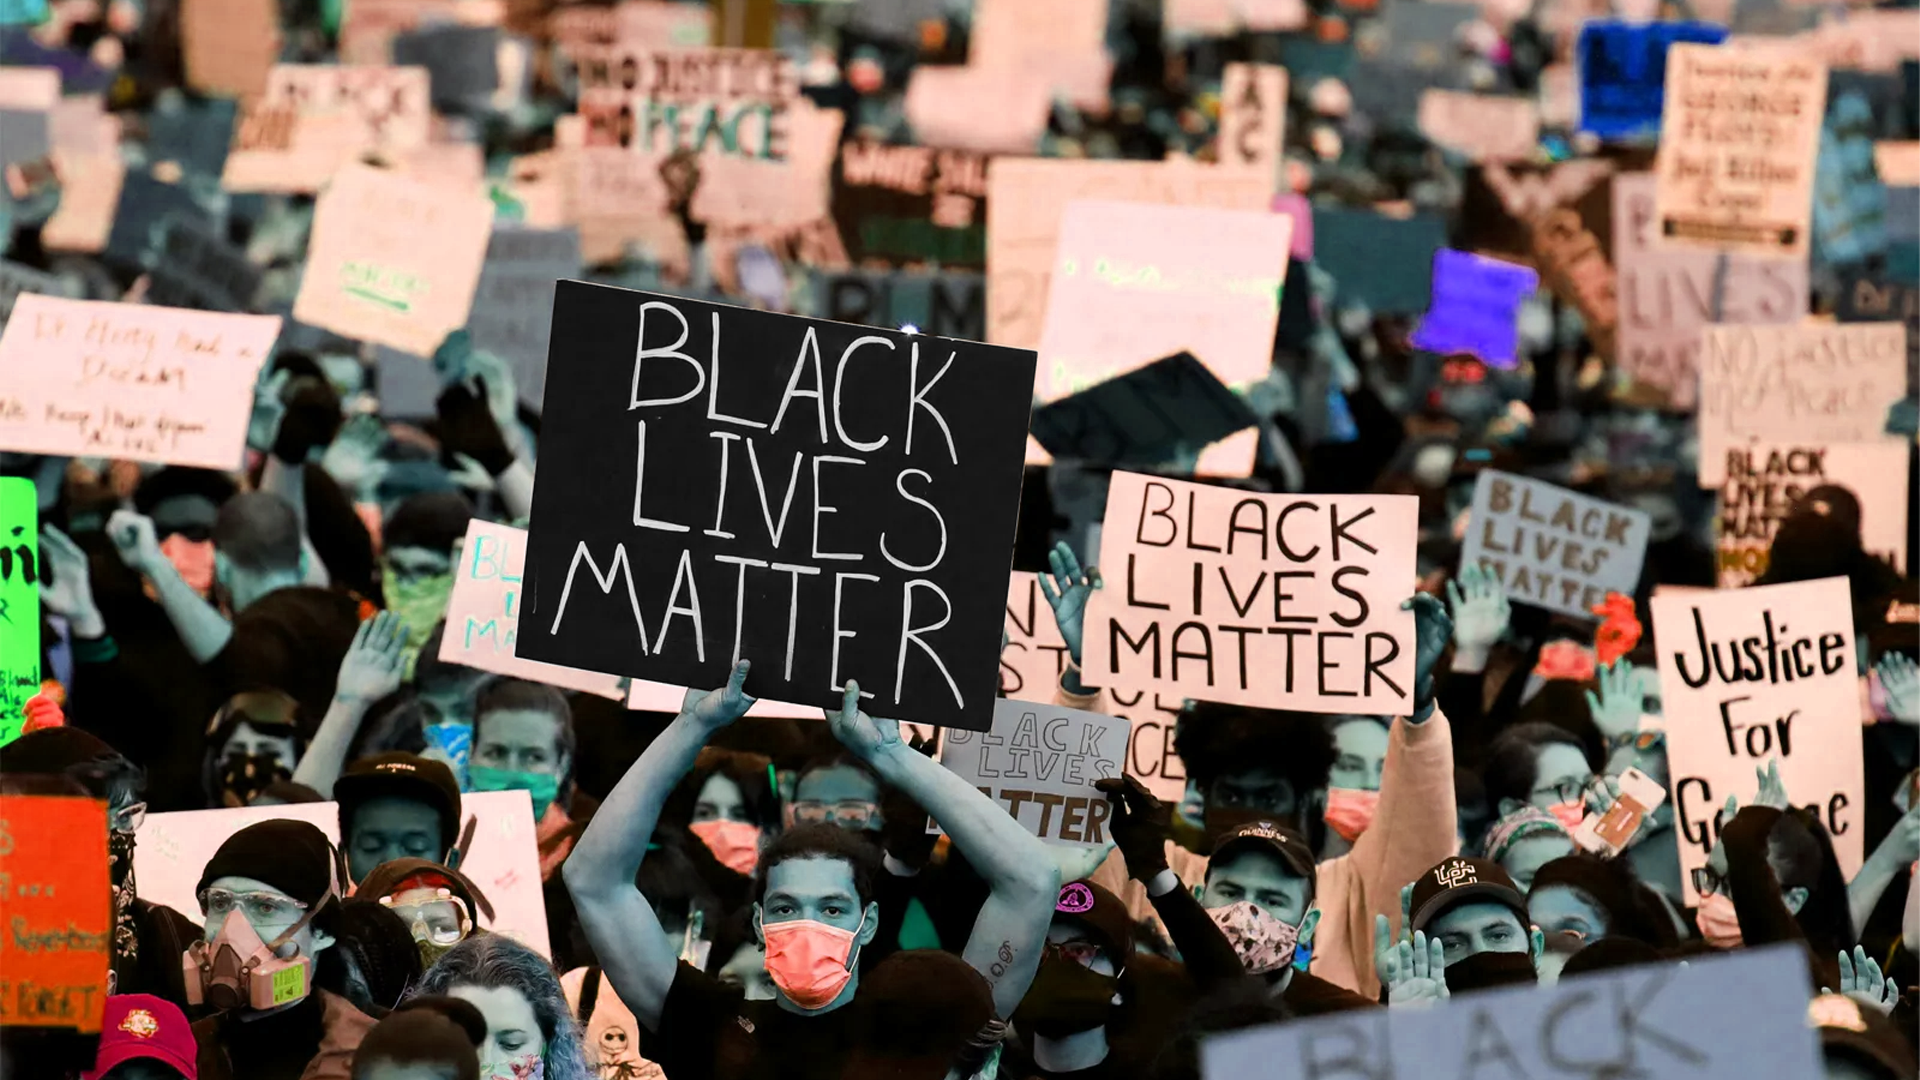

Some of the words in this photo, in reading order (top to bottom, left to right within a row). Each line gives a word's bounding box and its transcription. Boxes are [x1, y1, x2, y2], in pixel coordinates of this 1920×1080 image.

[644, 98, 788, 162] PEACE
[628, 301, 957, 465] BLACK
[633, 420, 948, 573] LIVES
[1728, 449, 1826, 475] BLACK
[1137, 482, 1379, 563] BLACK
[1481, 517, 1610, 577] LIVES
[1489, 477, 1633, 546] BLACK
[1127, 553, 1370, 628] LIVES
[1477, 554, 1616, 613] MATTE
[551, 541, 965, 709] MATTER
[1109, 616, 1407, 699] MATTER
[1674, 606, 1846, 689] Justice
[1719, 695, 1802, 758] For
[977, 745, 1115, 787] LIVES
